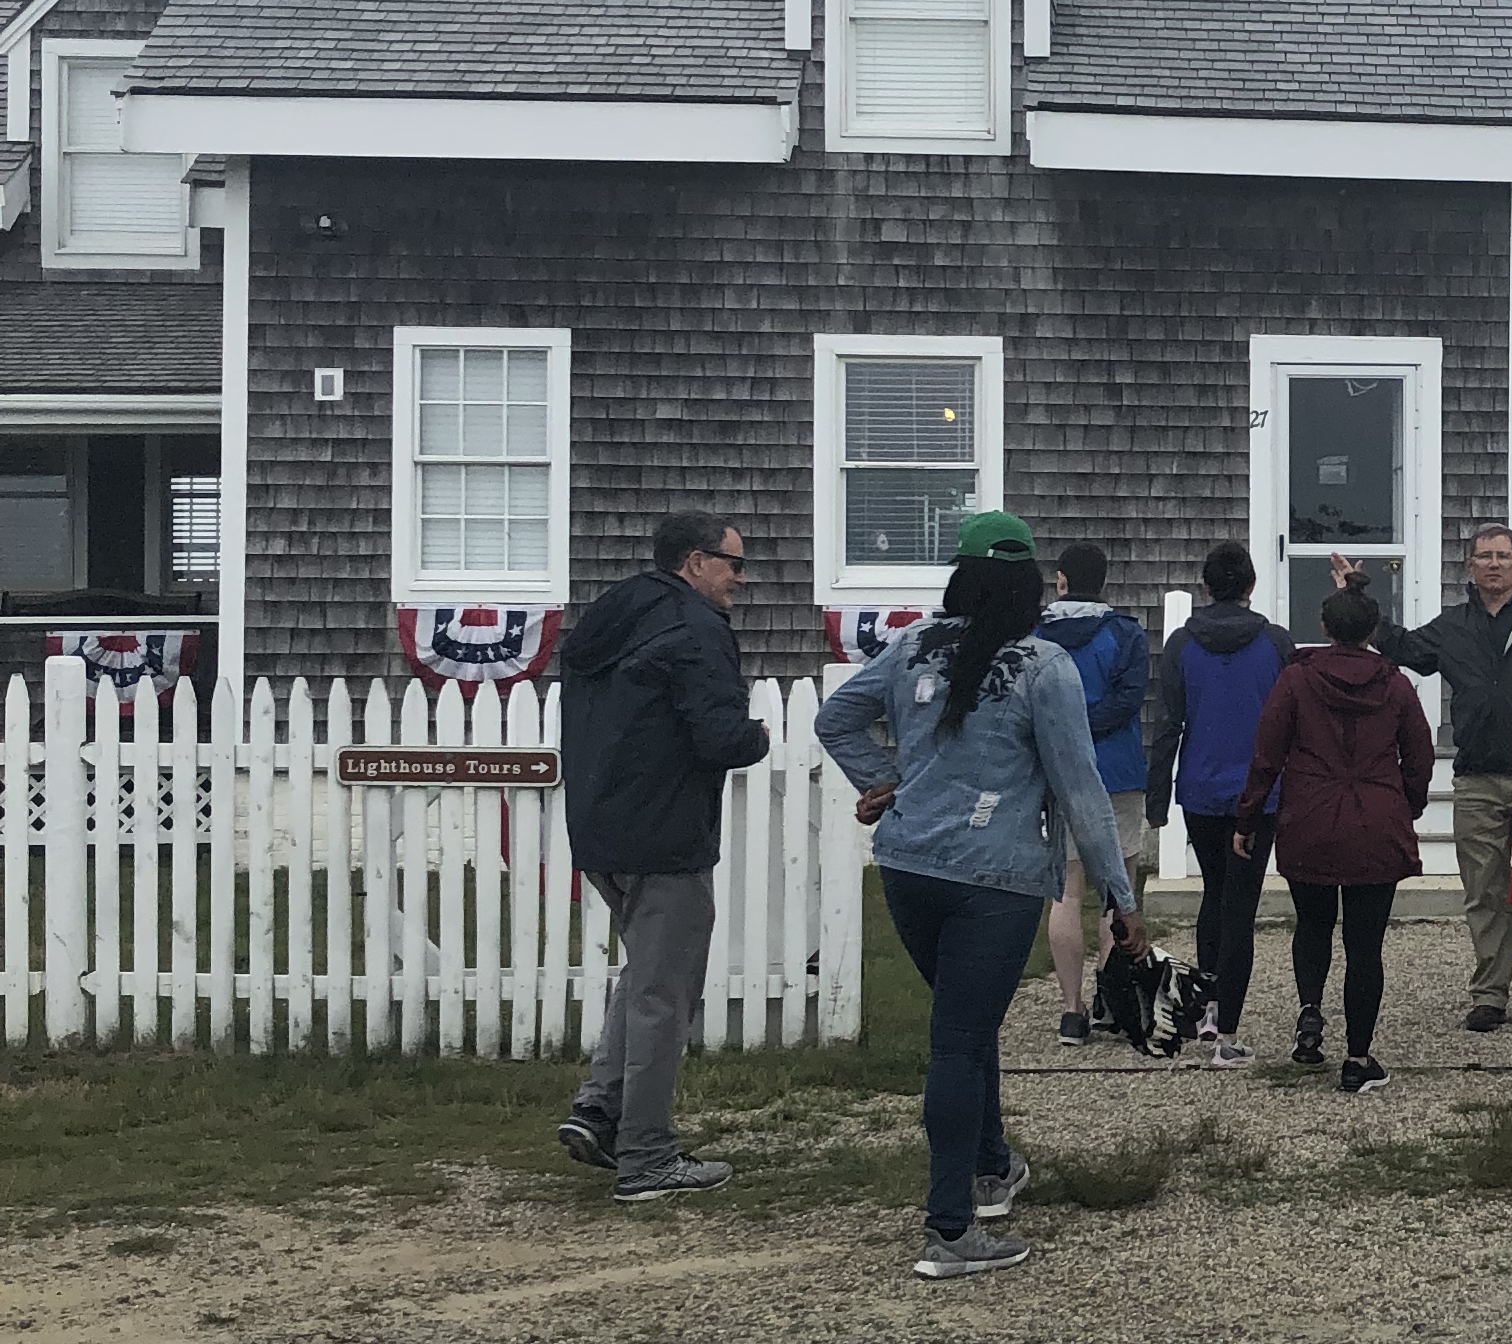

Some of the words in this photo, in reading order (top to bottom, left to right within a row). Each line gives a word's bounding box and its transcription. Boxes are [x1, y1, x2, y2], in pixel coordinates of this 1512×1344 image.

[1250, 410, 1269, 428] 27
[346, 758, 456, 777] Lighthouse
[466, 760, 522, 775] Tours
